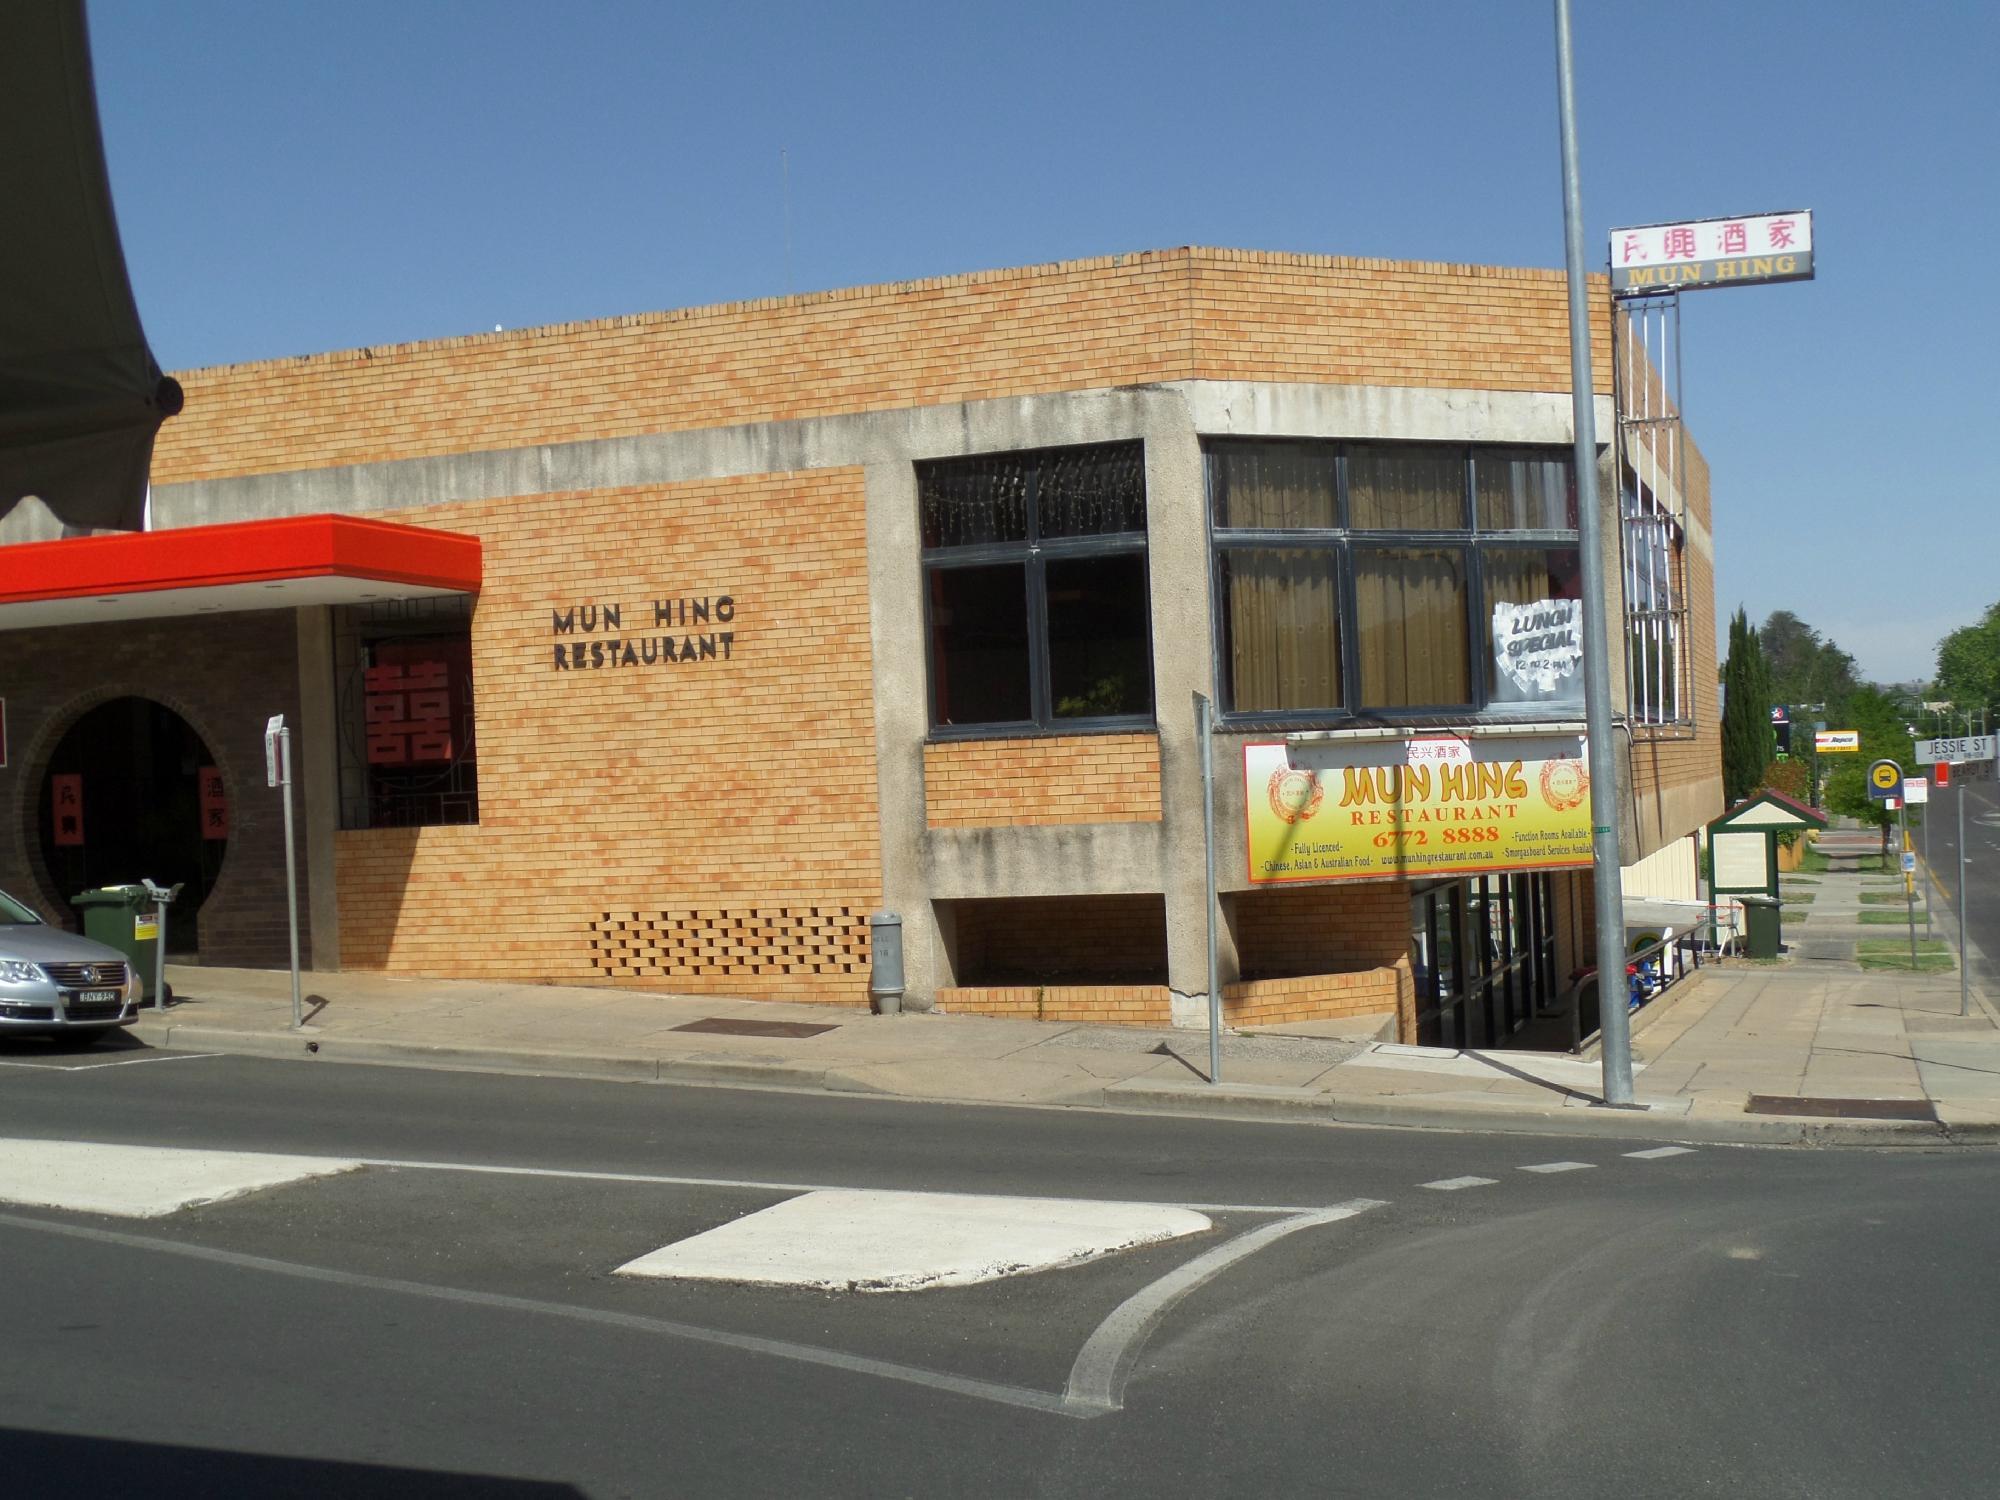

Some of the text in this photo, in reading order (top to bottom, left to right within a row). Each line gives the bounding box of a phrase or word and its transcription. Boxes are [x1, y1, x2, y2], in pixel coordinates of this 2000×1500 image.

[1628, 256, 1796, 286] MUN HING
[552, 595, 735, 636] MUN HING
[1511, 607, 1573, 635] LUNCH
[553, 631, 734, 671] RESTAURANT
[1506, 629, 1577, 658] SPECIAL
[1928, 740, 1967, 755] JESSIE
[1973, 738, 1987, 751] ST
[1339, 763, 1431, 807] MUN
[1440, 760, 1528, 802] HING
[1350, 804, 1518, 826] RESTAURANT
[1372, 826, 1500, 848] 6772 8888
[1540, 830, 1560, 840] Rooms
[1294, 859, 1312, 870] Asian
[1314, 858, 1319, 869] &
[1320, 856, 1354, 868] Australian
